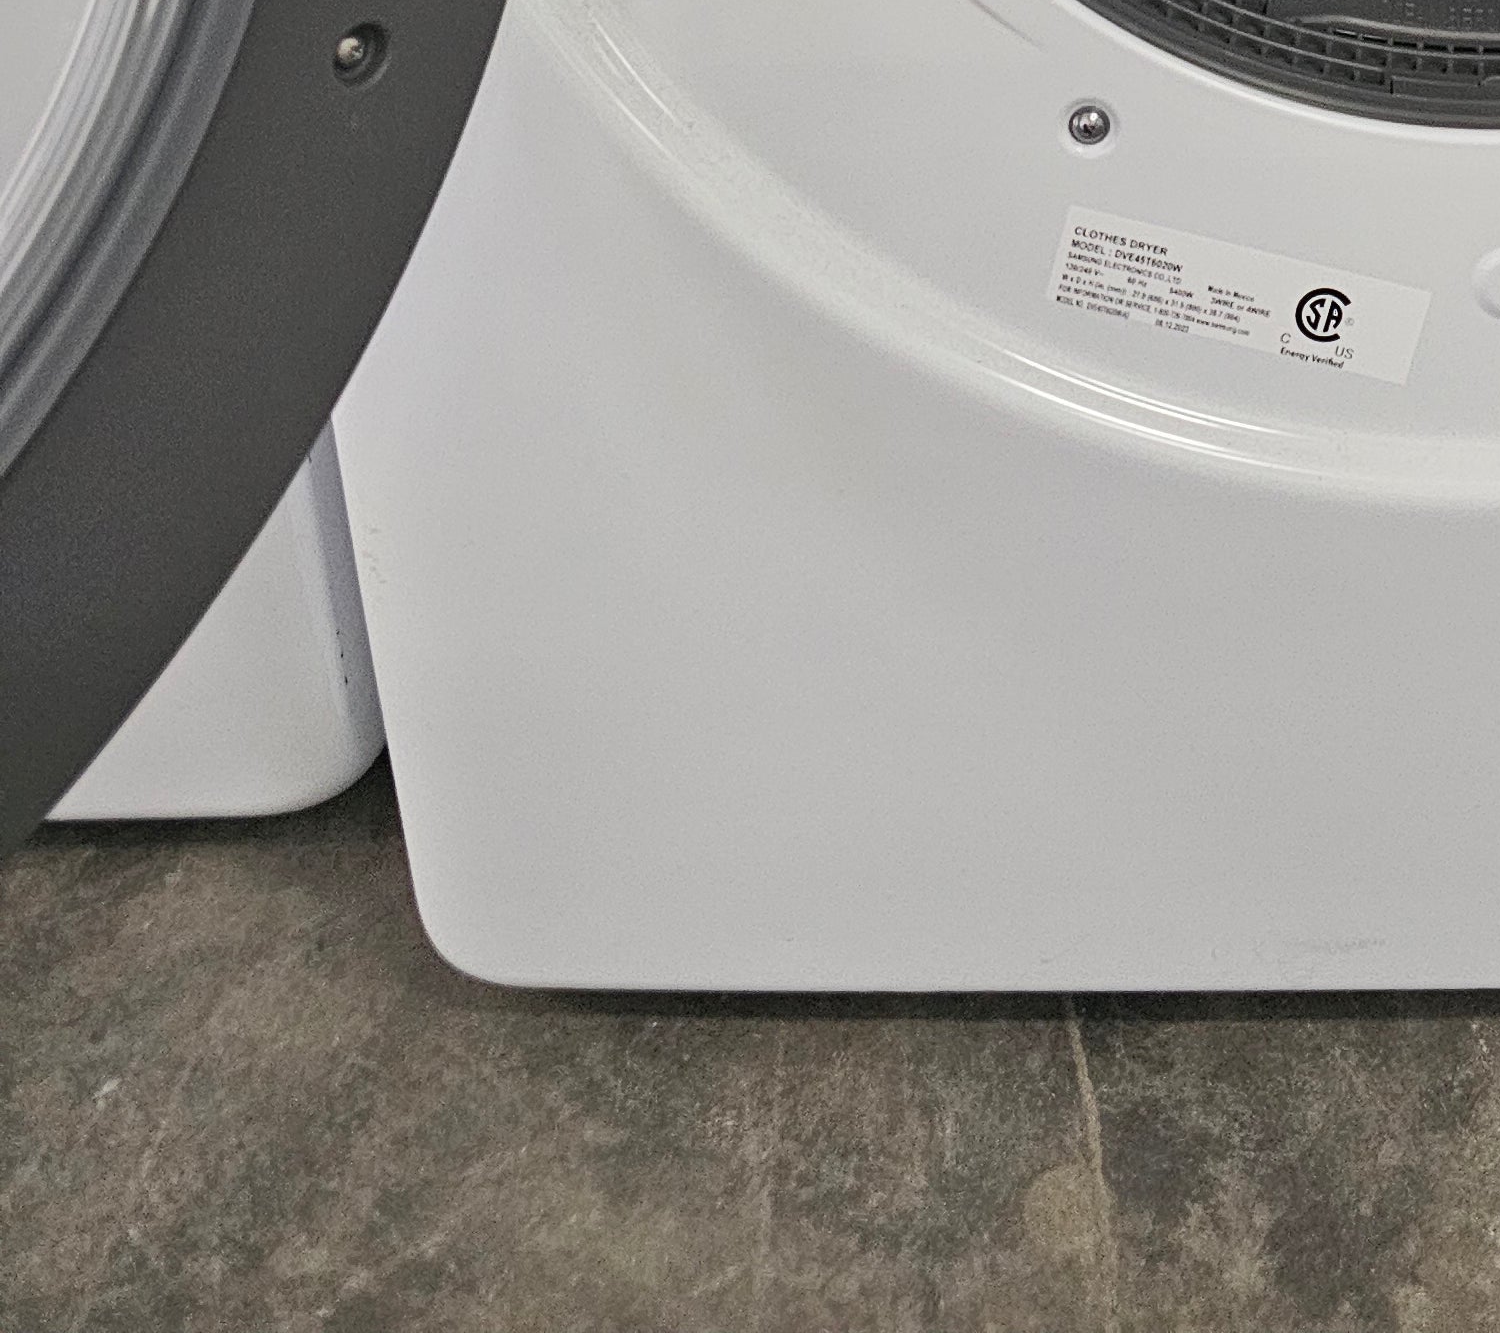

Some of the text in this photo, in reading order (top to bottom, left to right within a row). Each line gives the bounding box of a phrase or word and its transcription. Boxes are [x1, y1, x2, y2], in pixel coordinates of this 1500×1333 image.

[1071, 238, 1105, 255] MODEL
[1074, 226, 1169, 257] CLOTHES DRYER
[1280, 333, 1291, 344] C
[1280, 346, 1345, 369] Energy Verified
[1335, 346, 1354, 360] US
